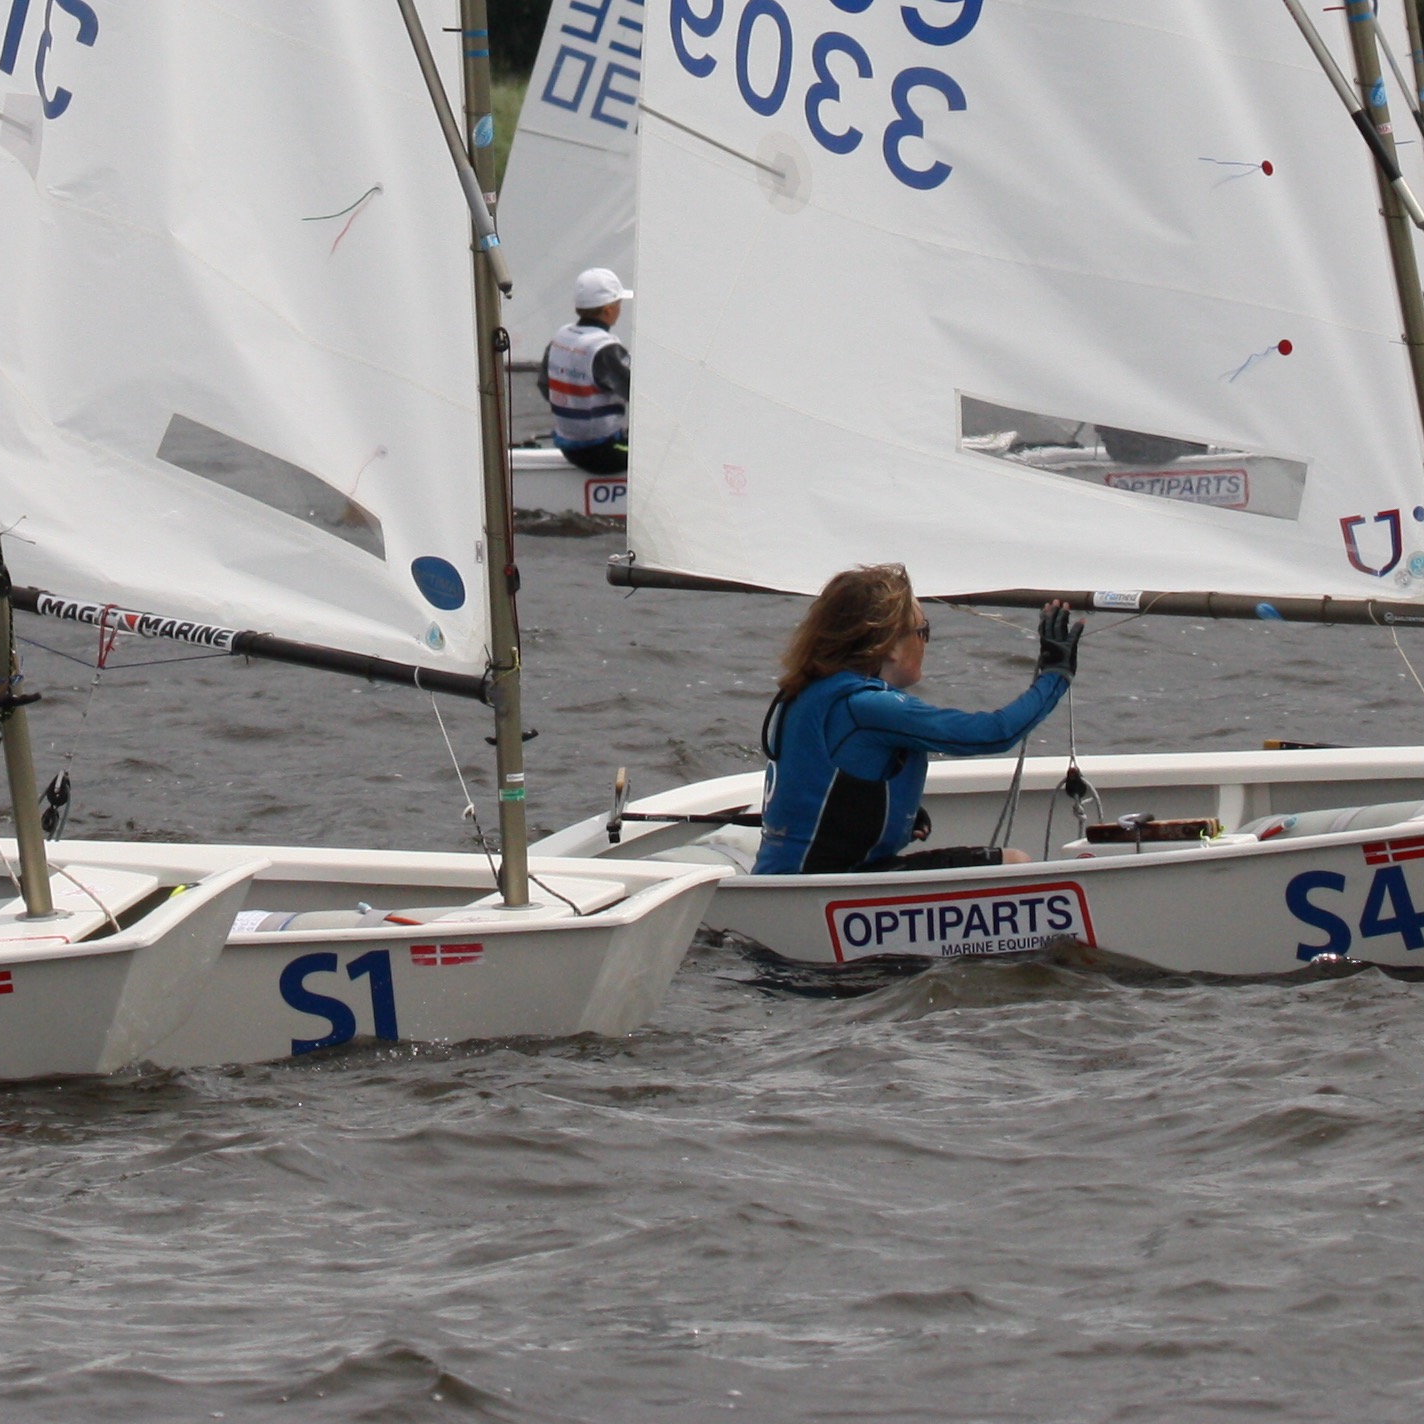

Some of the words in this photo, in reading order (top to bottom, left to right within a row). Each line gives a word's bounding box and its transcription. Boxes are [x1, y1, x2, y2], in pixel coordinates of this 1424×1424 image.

[137, 612, 234, 653] MARINE
[841, 895, 1074, 948] OPTIPARTS
[941, 940, 996, 956] MARINE
[998, 932, 1079, 951] EQUIPMT
[279, 949, 399, 1056] S1
